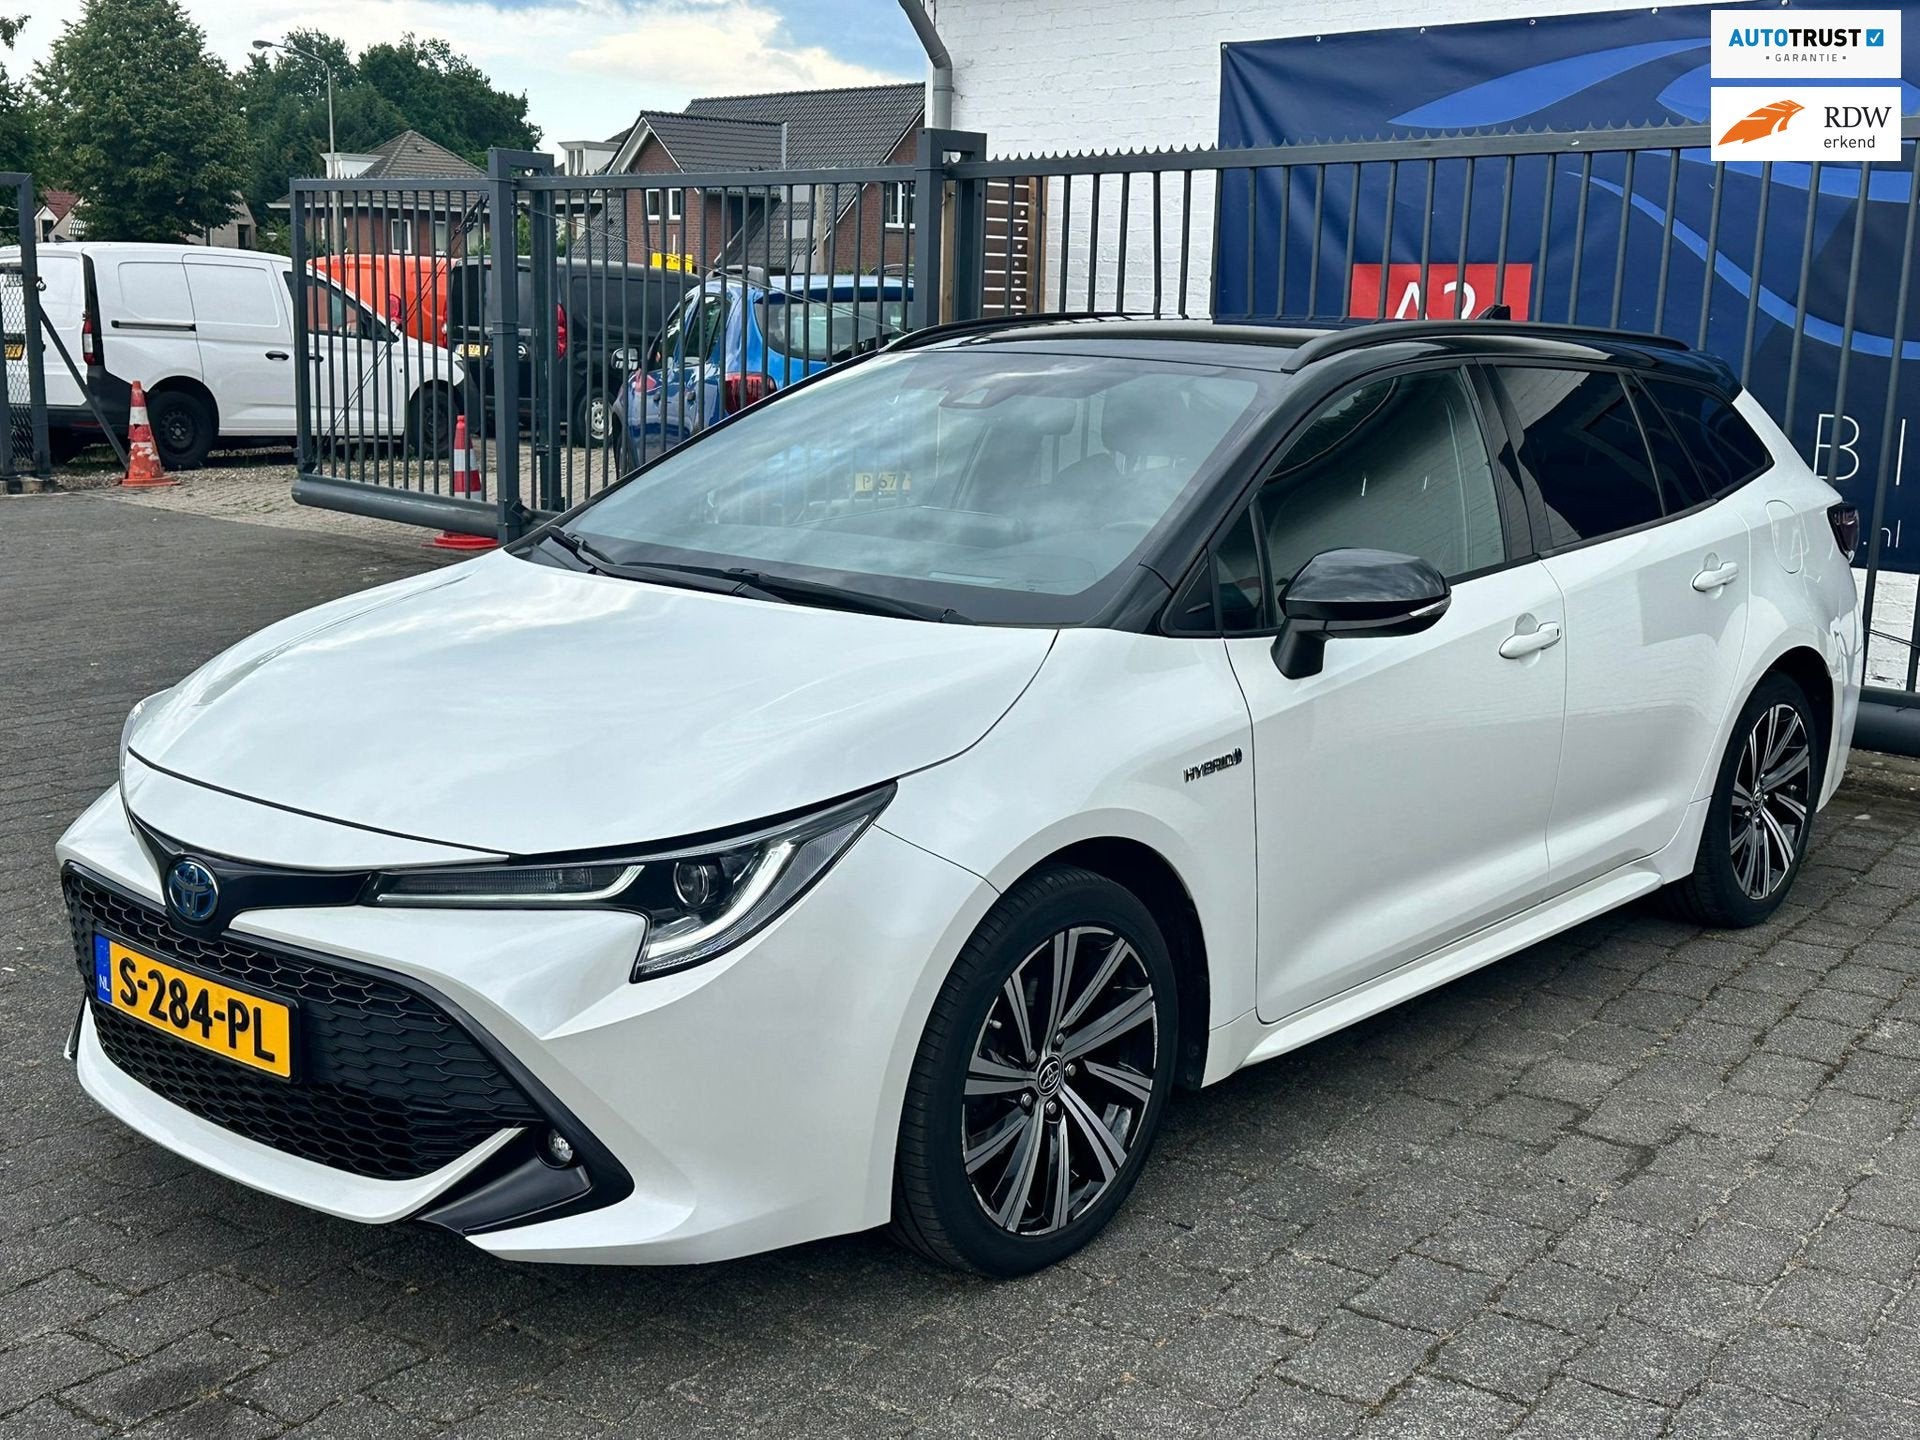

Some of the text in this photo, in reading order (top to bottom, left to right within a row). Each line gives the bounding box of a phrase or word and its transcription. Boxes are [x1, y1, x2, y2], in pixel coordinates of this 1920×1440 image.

[1183, 753, 1236, 783] HYBRID
[98, 974, 110, 992] NL
[119, 957, 276, 1063] S-284-PL
